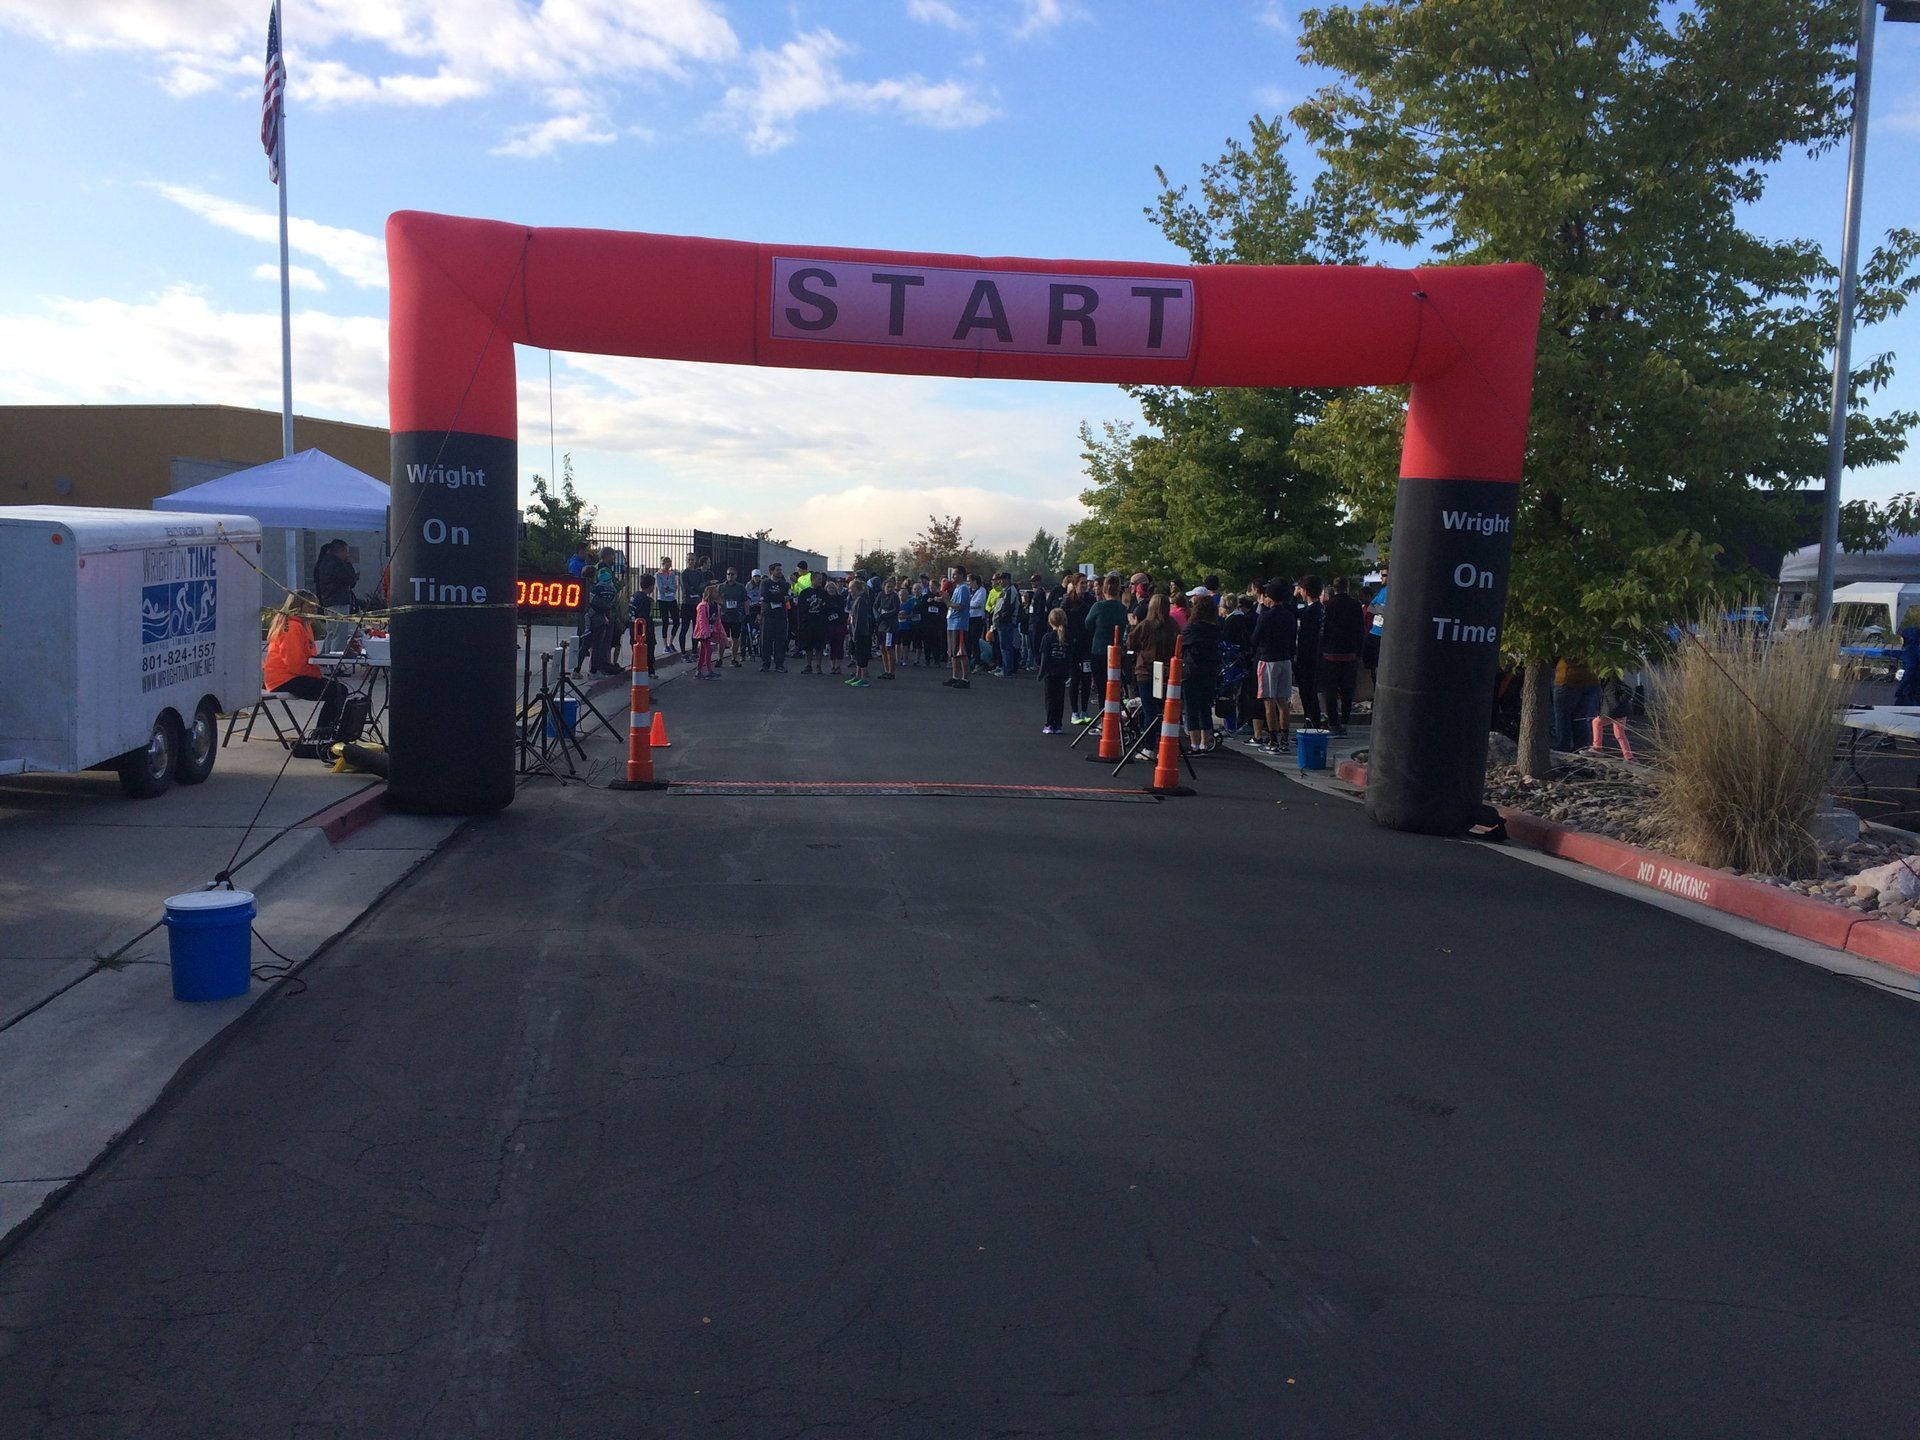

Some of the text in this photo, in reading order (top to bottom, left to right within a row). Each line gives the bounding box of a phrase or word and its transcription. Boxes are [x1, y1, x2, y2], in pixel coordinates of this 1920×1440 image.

[785, 268, 1183, 349] START
[406, 463, 486, 489] Wright
[423, 518, 470, 545] On
[1442, 510, 1510, 536] Wright
[187, 546, 217, 578] TIME
[1453, 563, 1494, 589] On
[409, 577, 487, 603] Time
[1432, 617, 1497, 643] Time
[142, 642, 216, 672] 801-824-1557
[1637, 861, 1710, 901] NO PARKING
